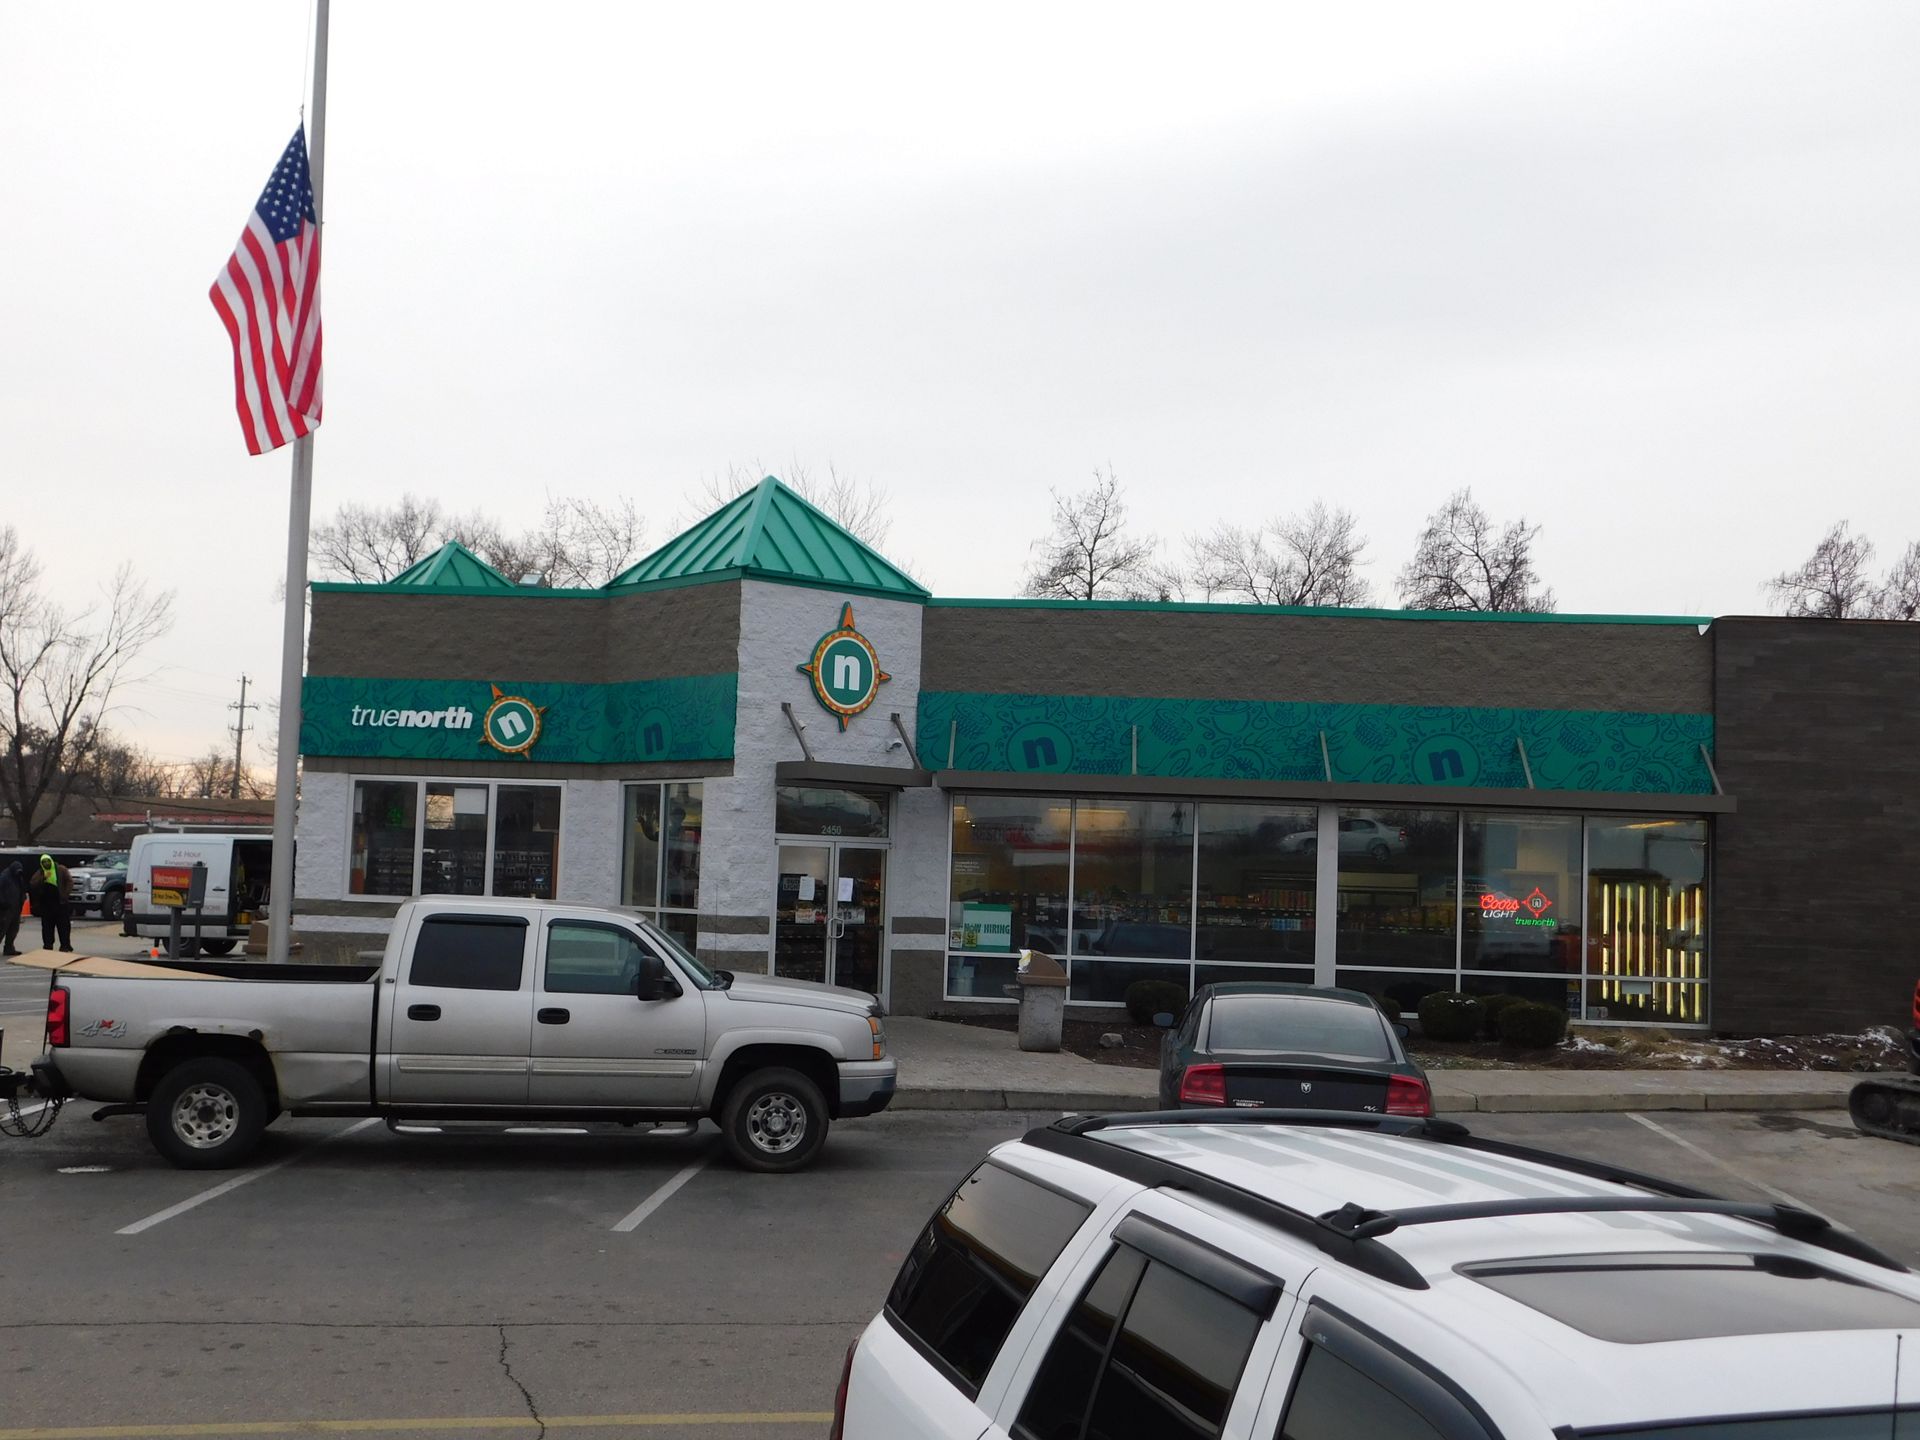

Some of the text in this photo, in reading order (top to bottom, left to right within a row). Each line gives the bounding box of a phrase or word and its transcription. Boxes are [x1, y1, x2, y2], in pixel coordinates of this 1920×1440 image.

[833, 654, 861, 691] n
[351, 704, 527, 740] truenorth n
[643, 722, 663, 754] n
[1022, 736, 1058, 769] n
[1428, 748, 1465, 781] n
[820, 825, 842, 835] 2450
[172, 850, 201, 858] 24 Hour
[1480, 894, 1520, 910] Coors
[1482, 910, 1517, 918] LIGHT
[964, 923, 1010, 934] NOW HIRING
